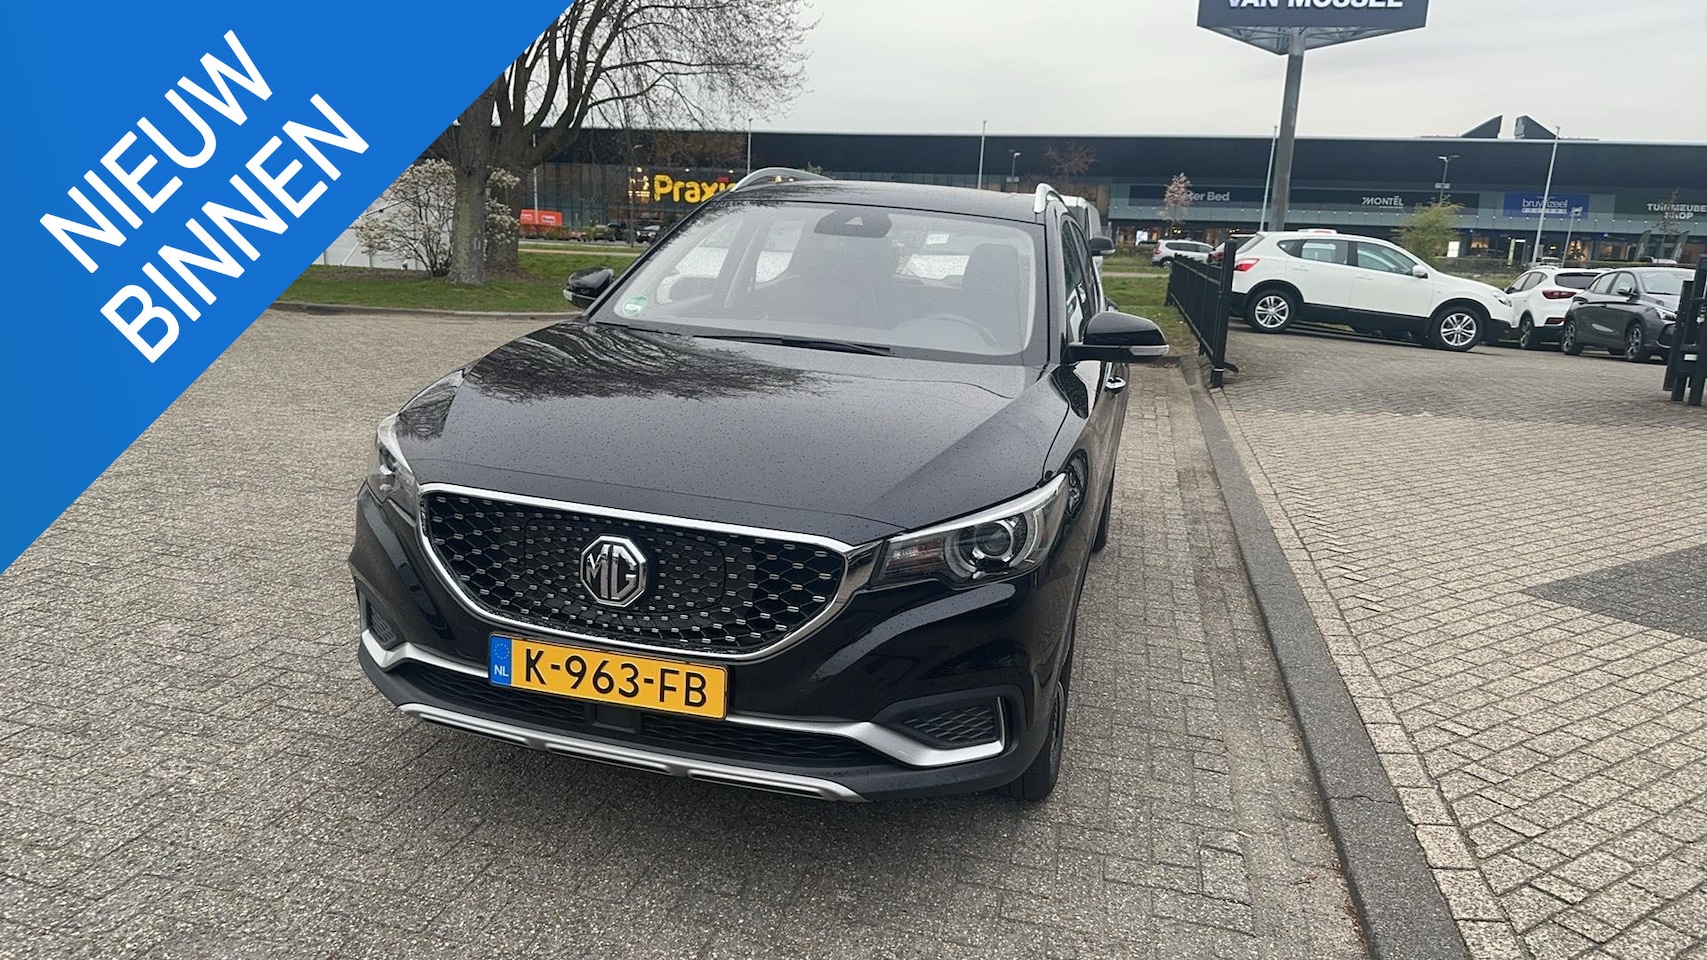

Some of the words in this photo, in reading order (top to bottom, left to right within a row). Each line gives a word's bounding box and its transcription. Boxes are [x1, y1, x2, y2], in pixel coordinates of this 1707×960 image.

[654, 174, 736, 203] Praxi
[1207, 191, 1230, 201] Bed
[586, 544, 637, 600] MG
[494, 664, 510, 677] NL
[525, 648, 707, 707] K-963-FB
